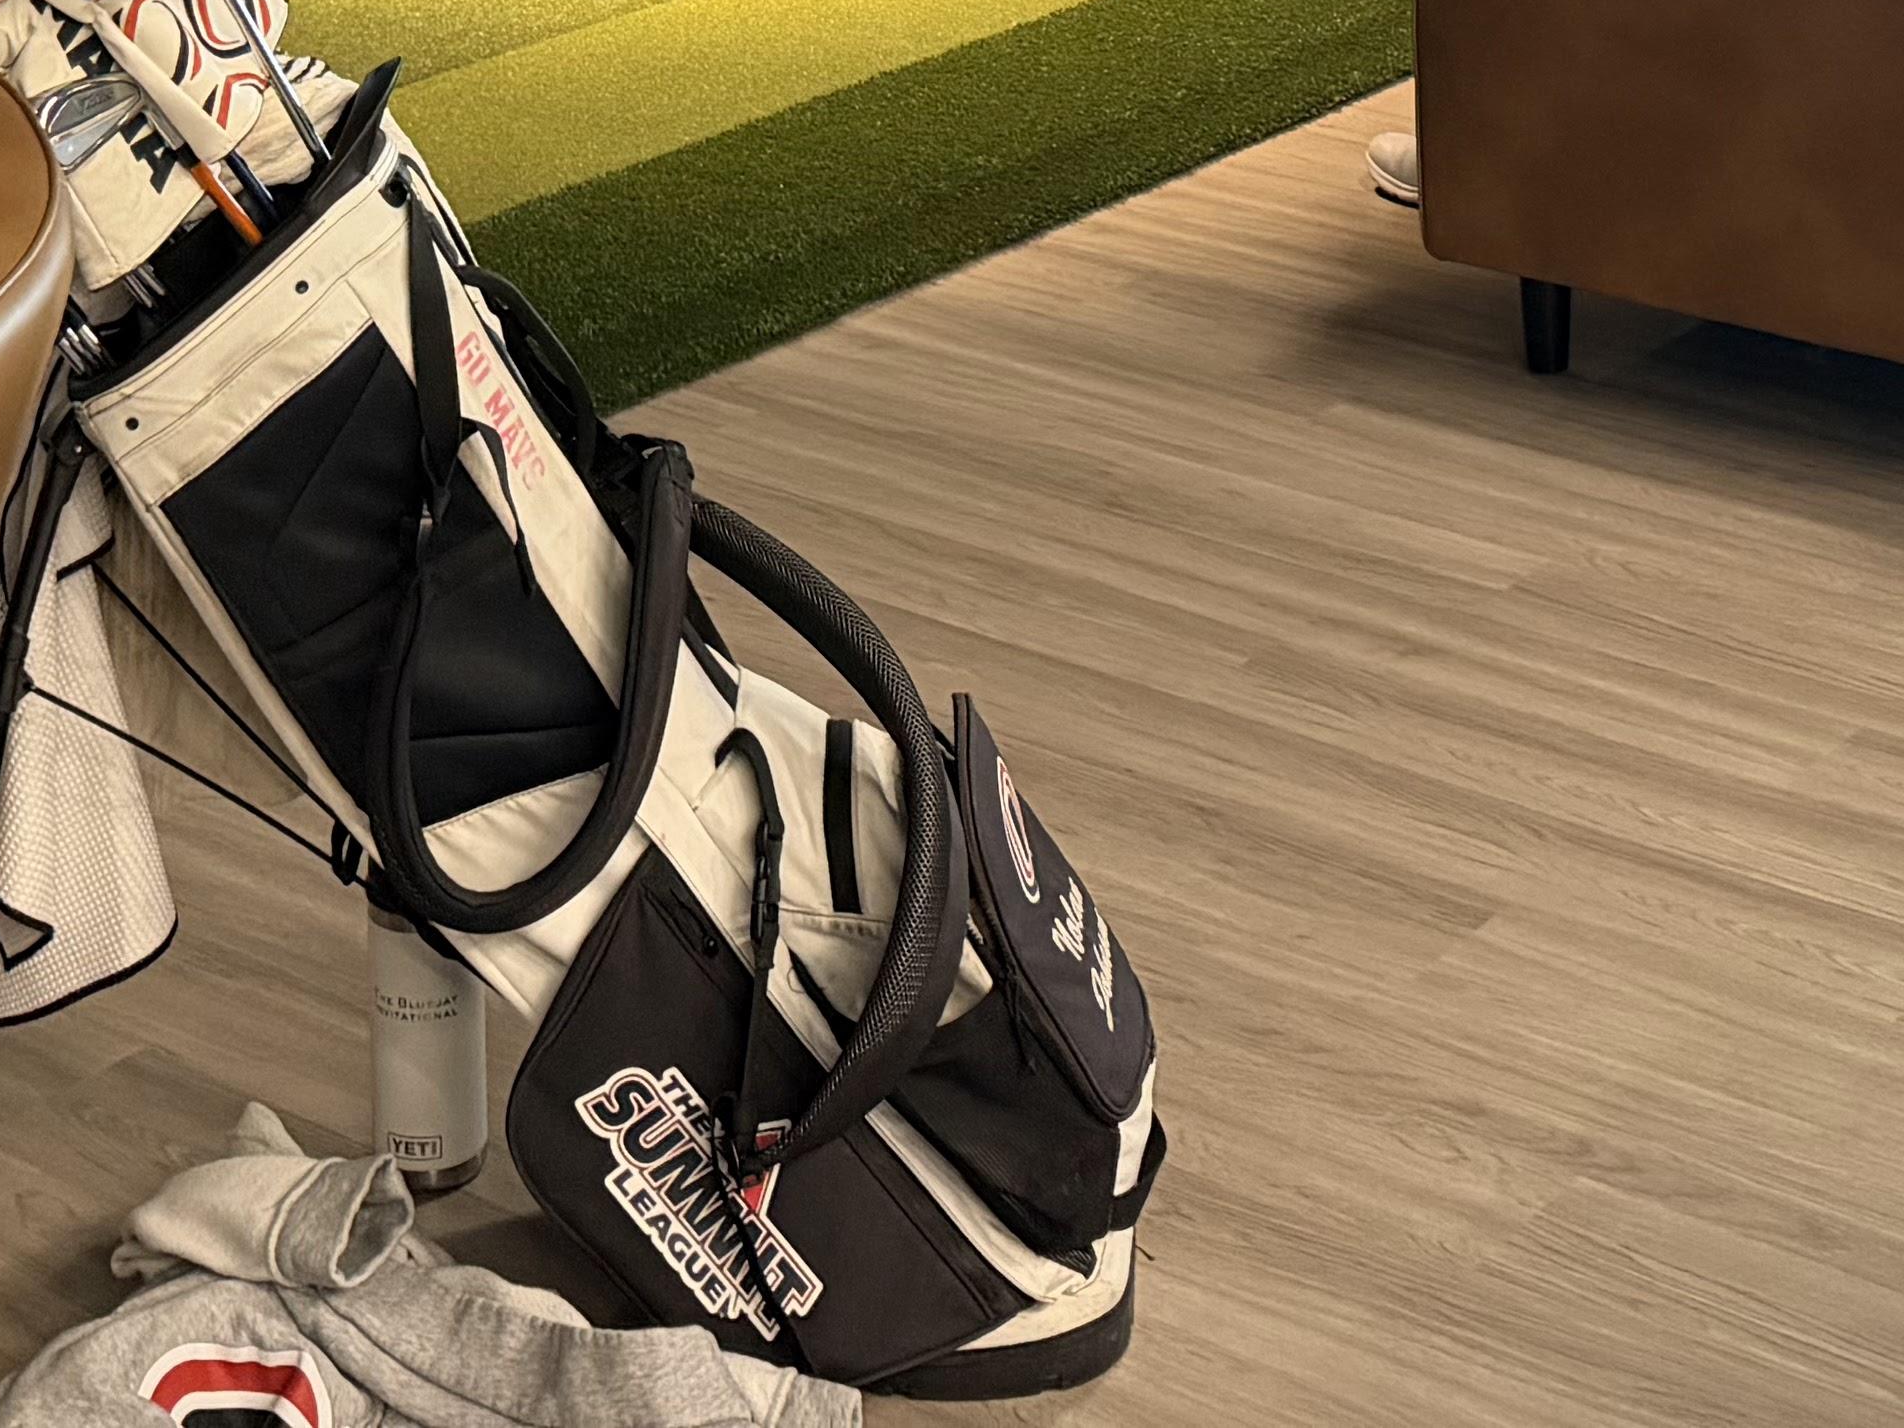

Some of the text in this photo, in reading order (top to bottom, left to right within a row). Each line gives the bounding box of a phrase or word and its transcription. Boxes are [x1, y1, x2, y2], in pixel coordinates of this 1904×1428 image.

[661, 1074, 714, 1139] THE
[392, 1137, 438, 1157] YETI
[611, 1168, 729, 1306] LEAGUE
